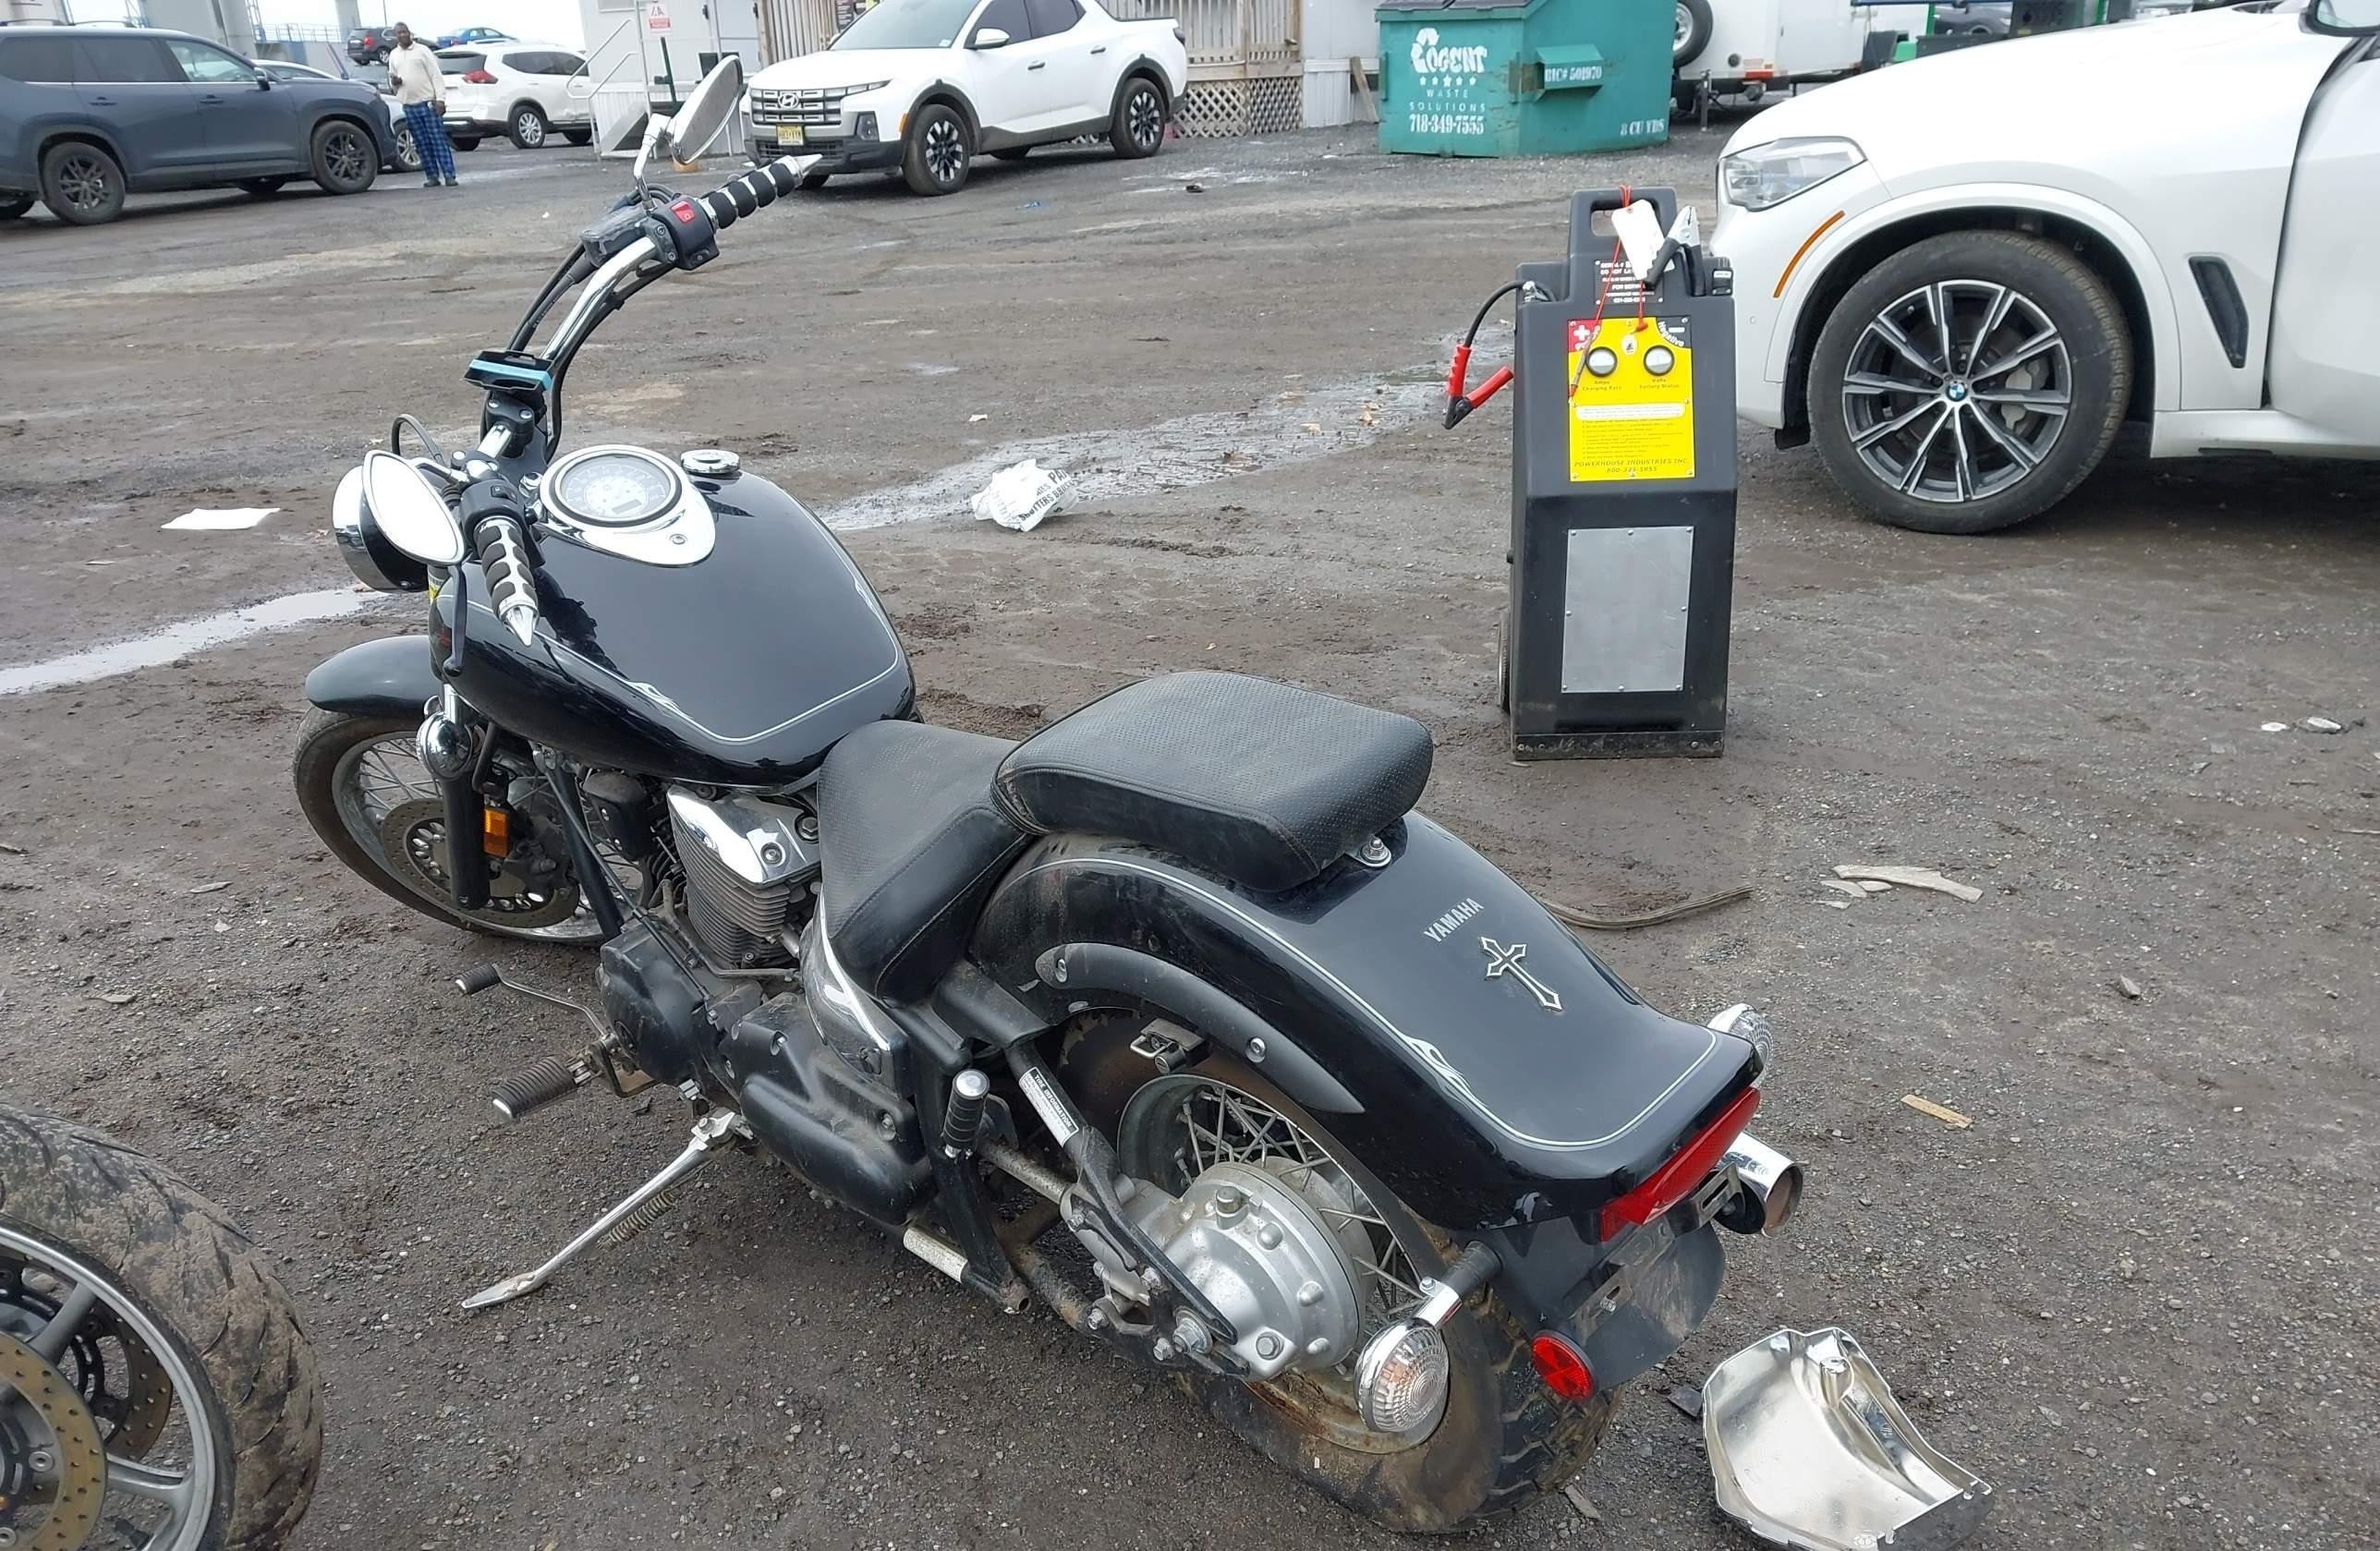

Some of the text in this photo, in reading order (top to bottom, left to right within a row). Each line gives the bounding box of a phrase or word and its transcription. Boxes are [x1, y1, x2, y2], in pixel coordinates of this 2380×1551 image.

[1427, 89, 1468, 98] WASTE
[1410, 102, 1486, 113] SOLUTIONS
[1409, 114, 1484, 135] 718-349-7555
[1657, 321, 1684, 346] Negative
[1573, 459, 1626, 467] POWERHOUSE
[1423, 897, 1485, 942] YAMAHA
[1043, 1089, 1072, 1128] INFORMATION
